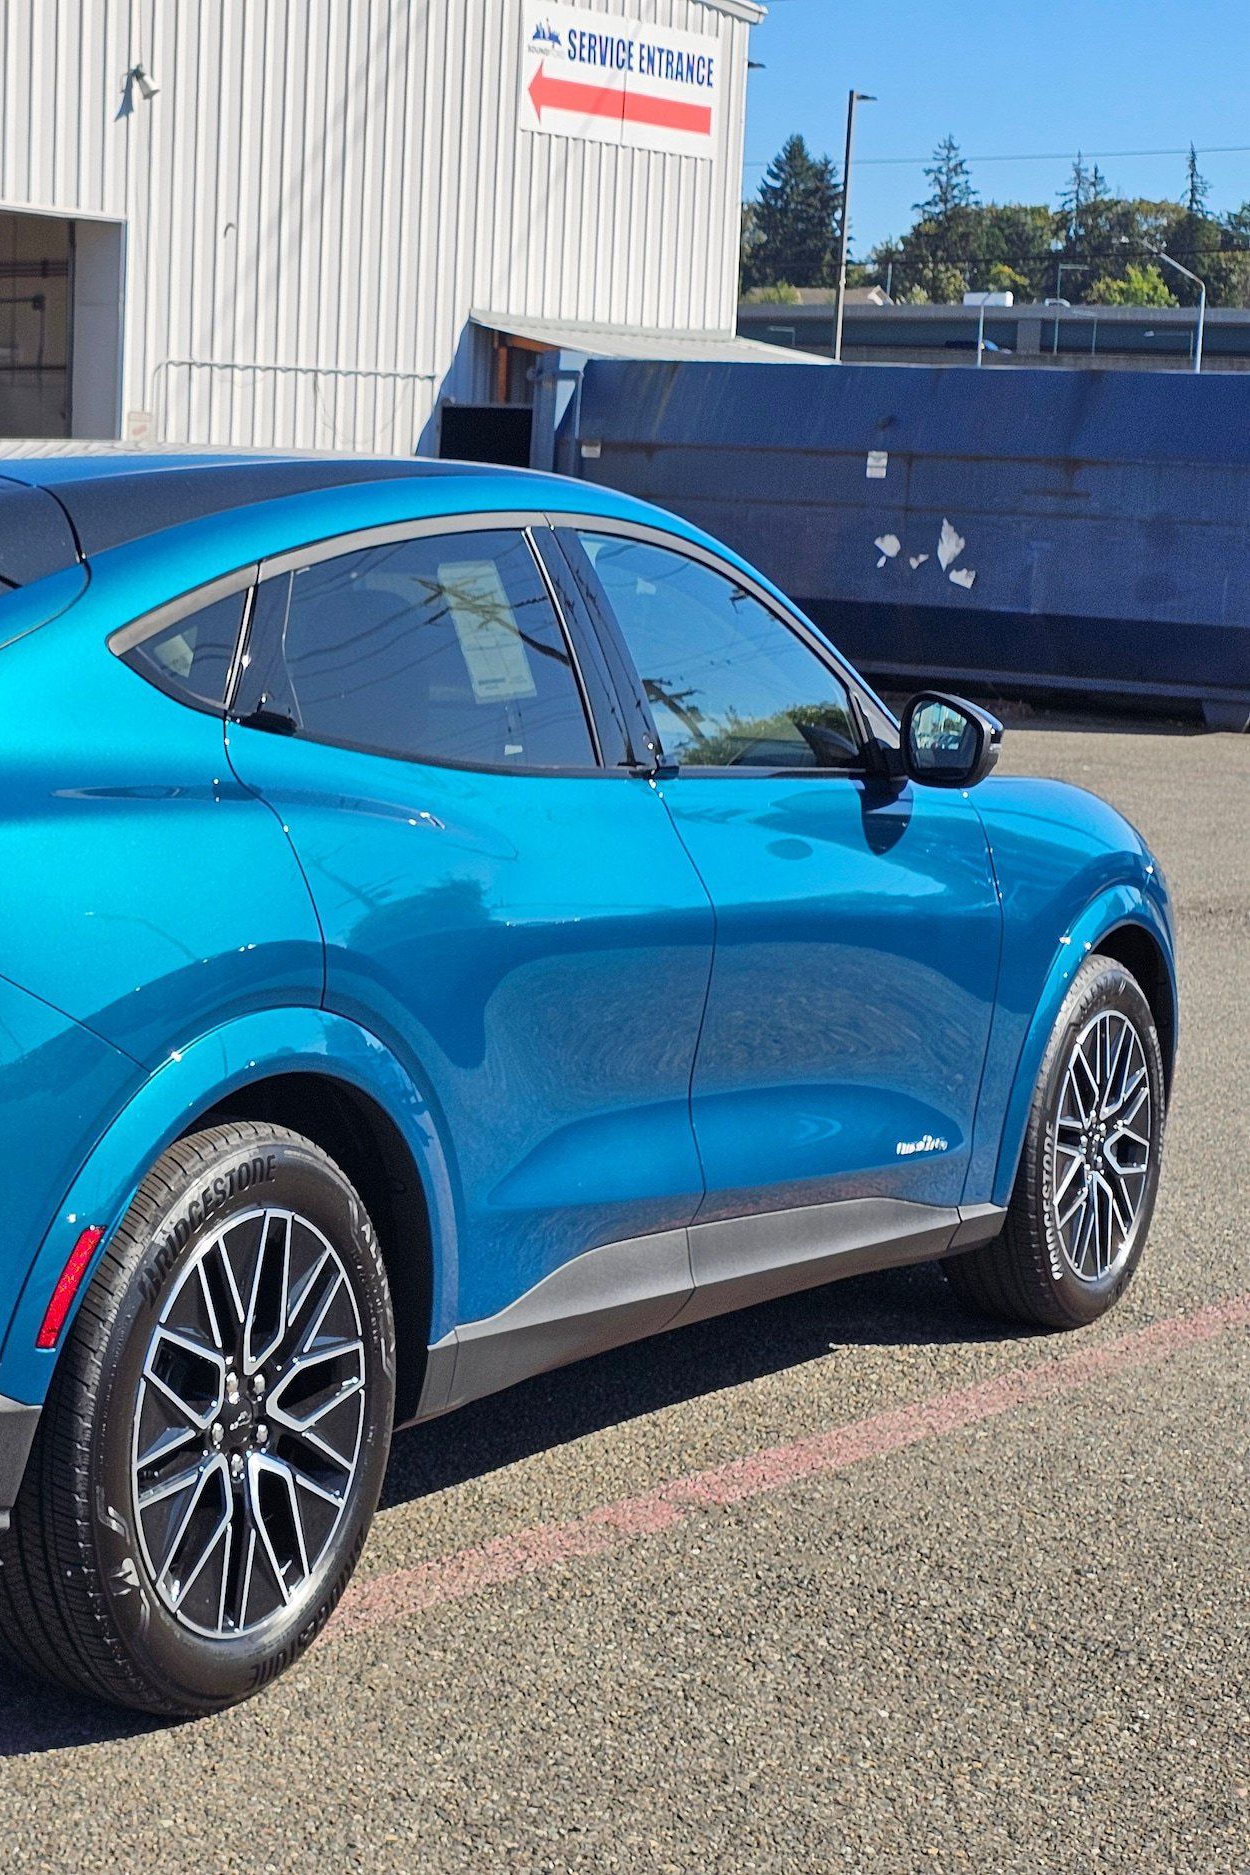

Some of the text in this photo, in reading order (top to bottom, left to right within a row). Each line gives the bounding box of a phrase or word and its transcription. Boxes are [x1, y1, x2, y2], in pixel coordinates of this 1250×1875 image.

[567, 28, 714, 89] SERVICE ENTRANCE
[137, 1154, 278, 1306] BRIDGESTONE
